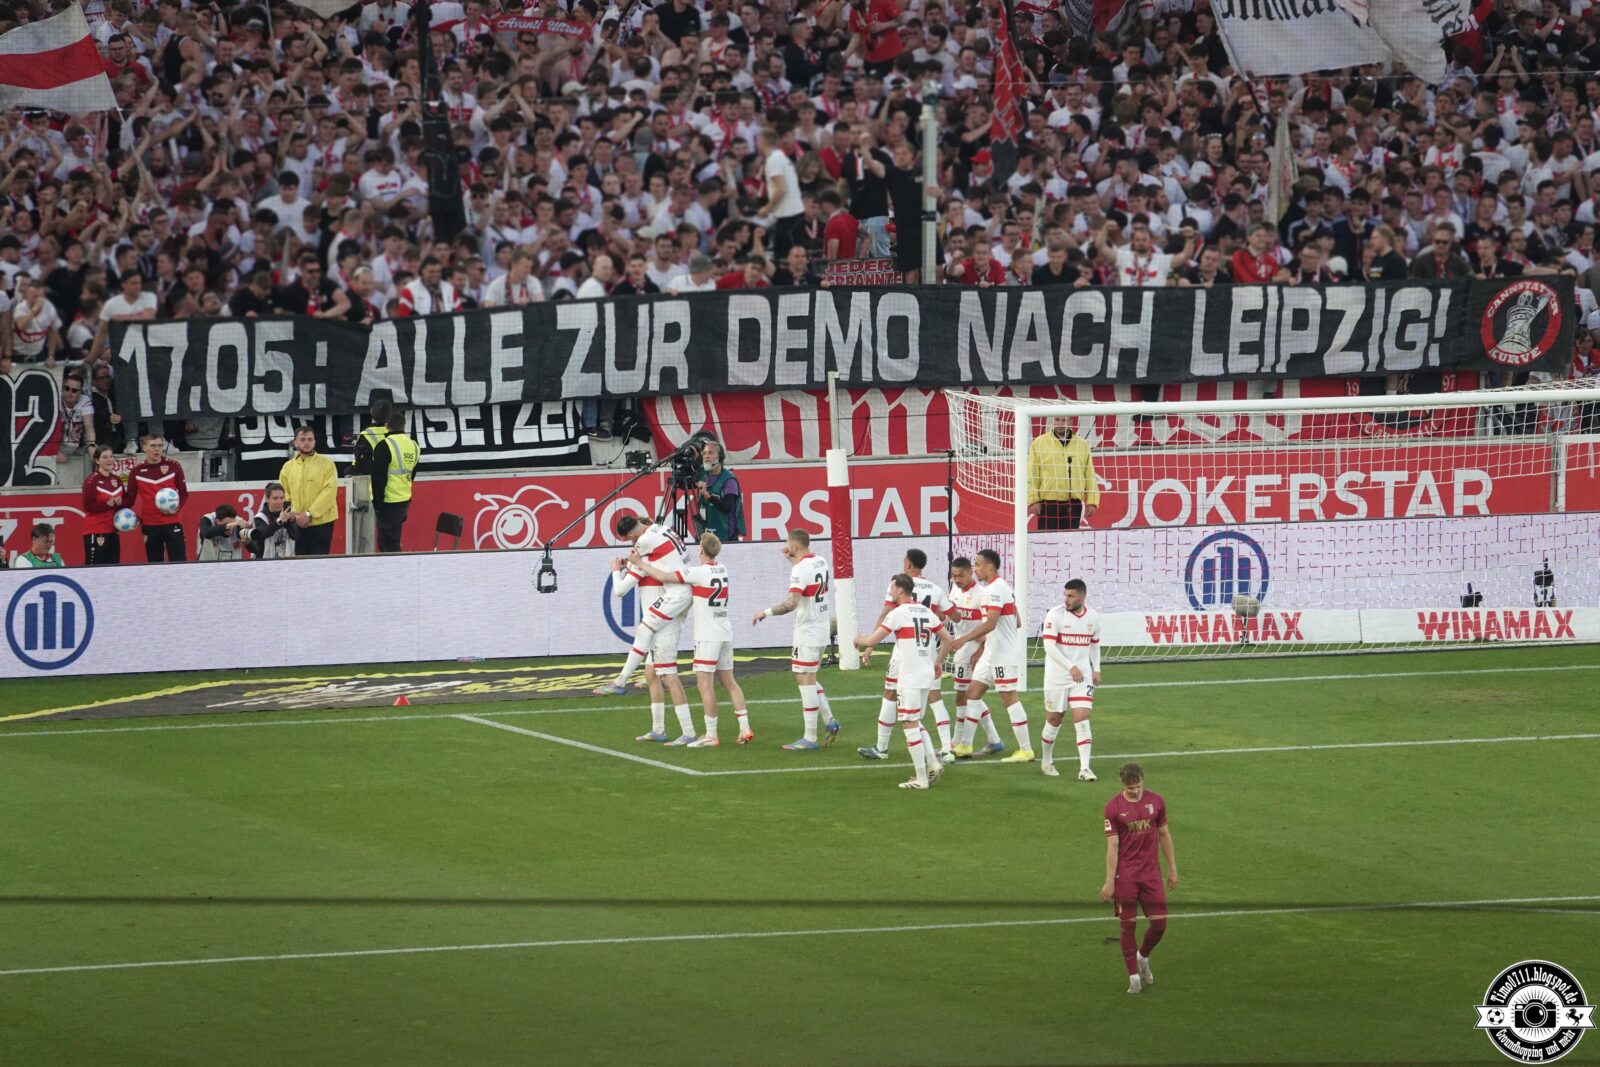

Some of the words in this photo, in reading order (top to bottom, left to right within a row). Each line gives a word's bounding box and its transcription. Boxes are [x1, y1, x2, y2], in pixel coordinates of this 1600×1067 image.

[498, 17, 543, 30] Avanti
[826, 260, 894, 274] JEDER
[119, 321, 328, 418] 17.05.:
[354, 311, 525, 407] ALLE
[556, 301, 691, 399] ZUR
[727, 291, 920, 386] DEMO
[957, 290, 1155, 383] NACH
[1190, 286, 1452, 377] LEIPZIG!
[1488, 347, 1542, 364] KURVE
[1346, 381, 1360, 396] 19
[1442, 374, 1456, 391] 97
[1111, 469, 1494, 528] JOKERSTAR
[708, 578, 729, 607] 27
[912, 617, 930, 648] 15
[1144, 611, 1304, 644] WINAMAX
[1417, 609, 1575, 641] WINAMAX
[957, 666, 964, 679] 8
[994, 666, 1005, 679] 18
